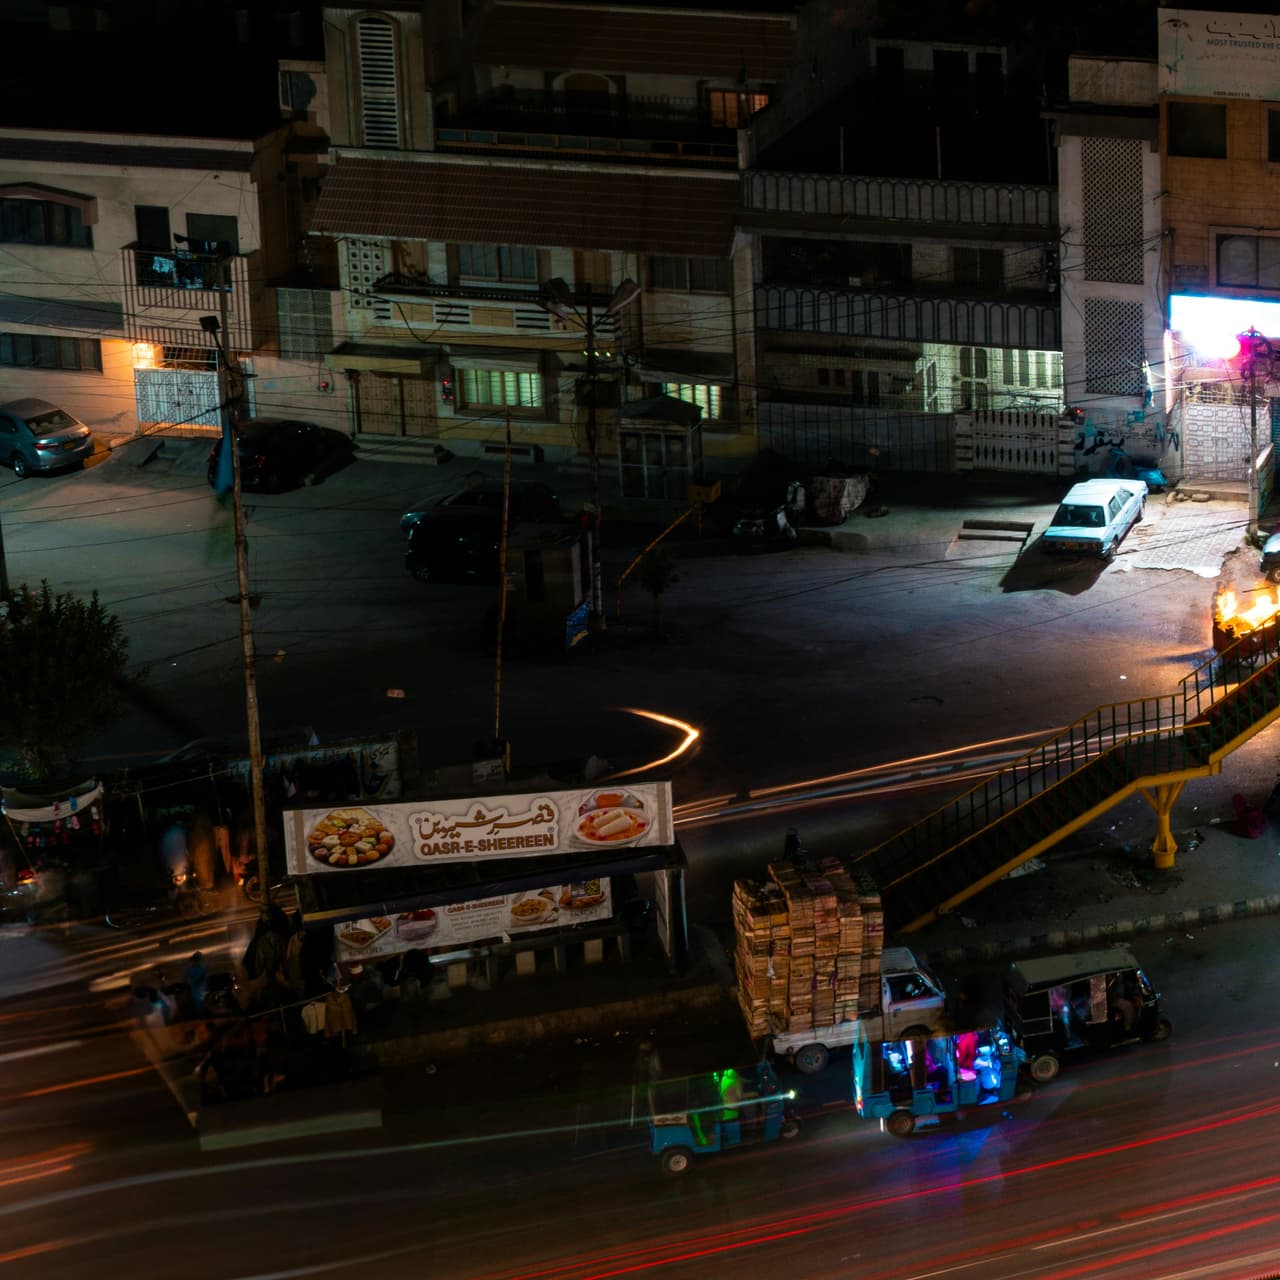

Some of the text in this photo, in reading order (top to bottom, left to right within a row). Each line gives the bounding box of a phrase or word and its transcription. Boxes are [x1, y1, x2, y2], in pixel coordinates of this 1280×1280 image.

[1206, 38, 1229, 46] MOST
[1230, 39, 1261, 49] TRUSTED
[1262, 41, 1275, 50] EYE
[420, 833, 555, 857] QASR-E-SHEEREEN
